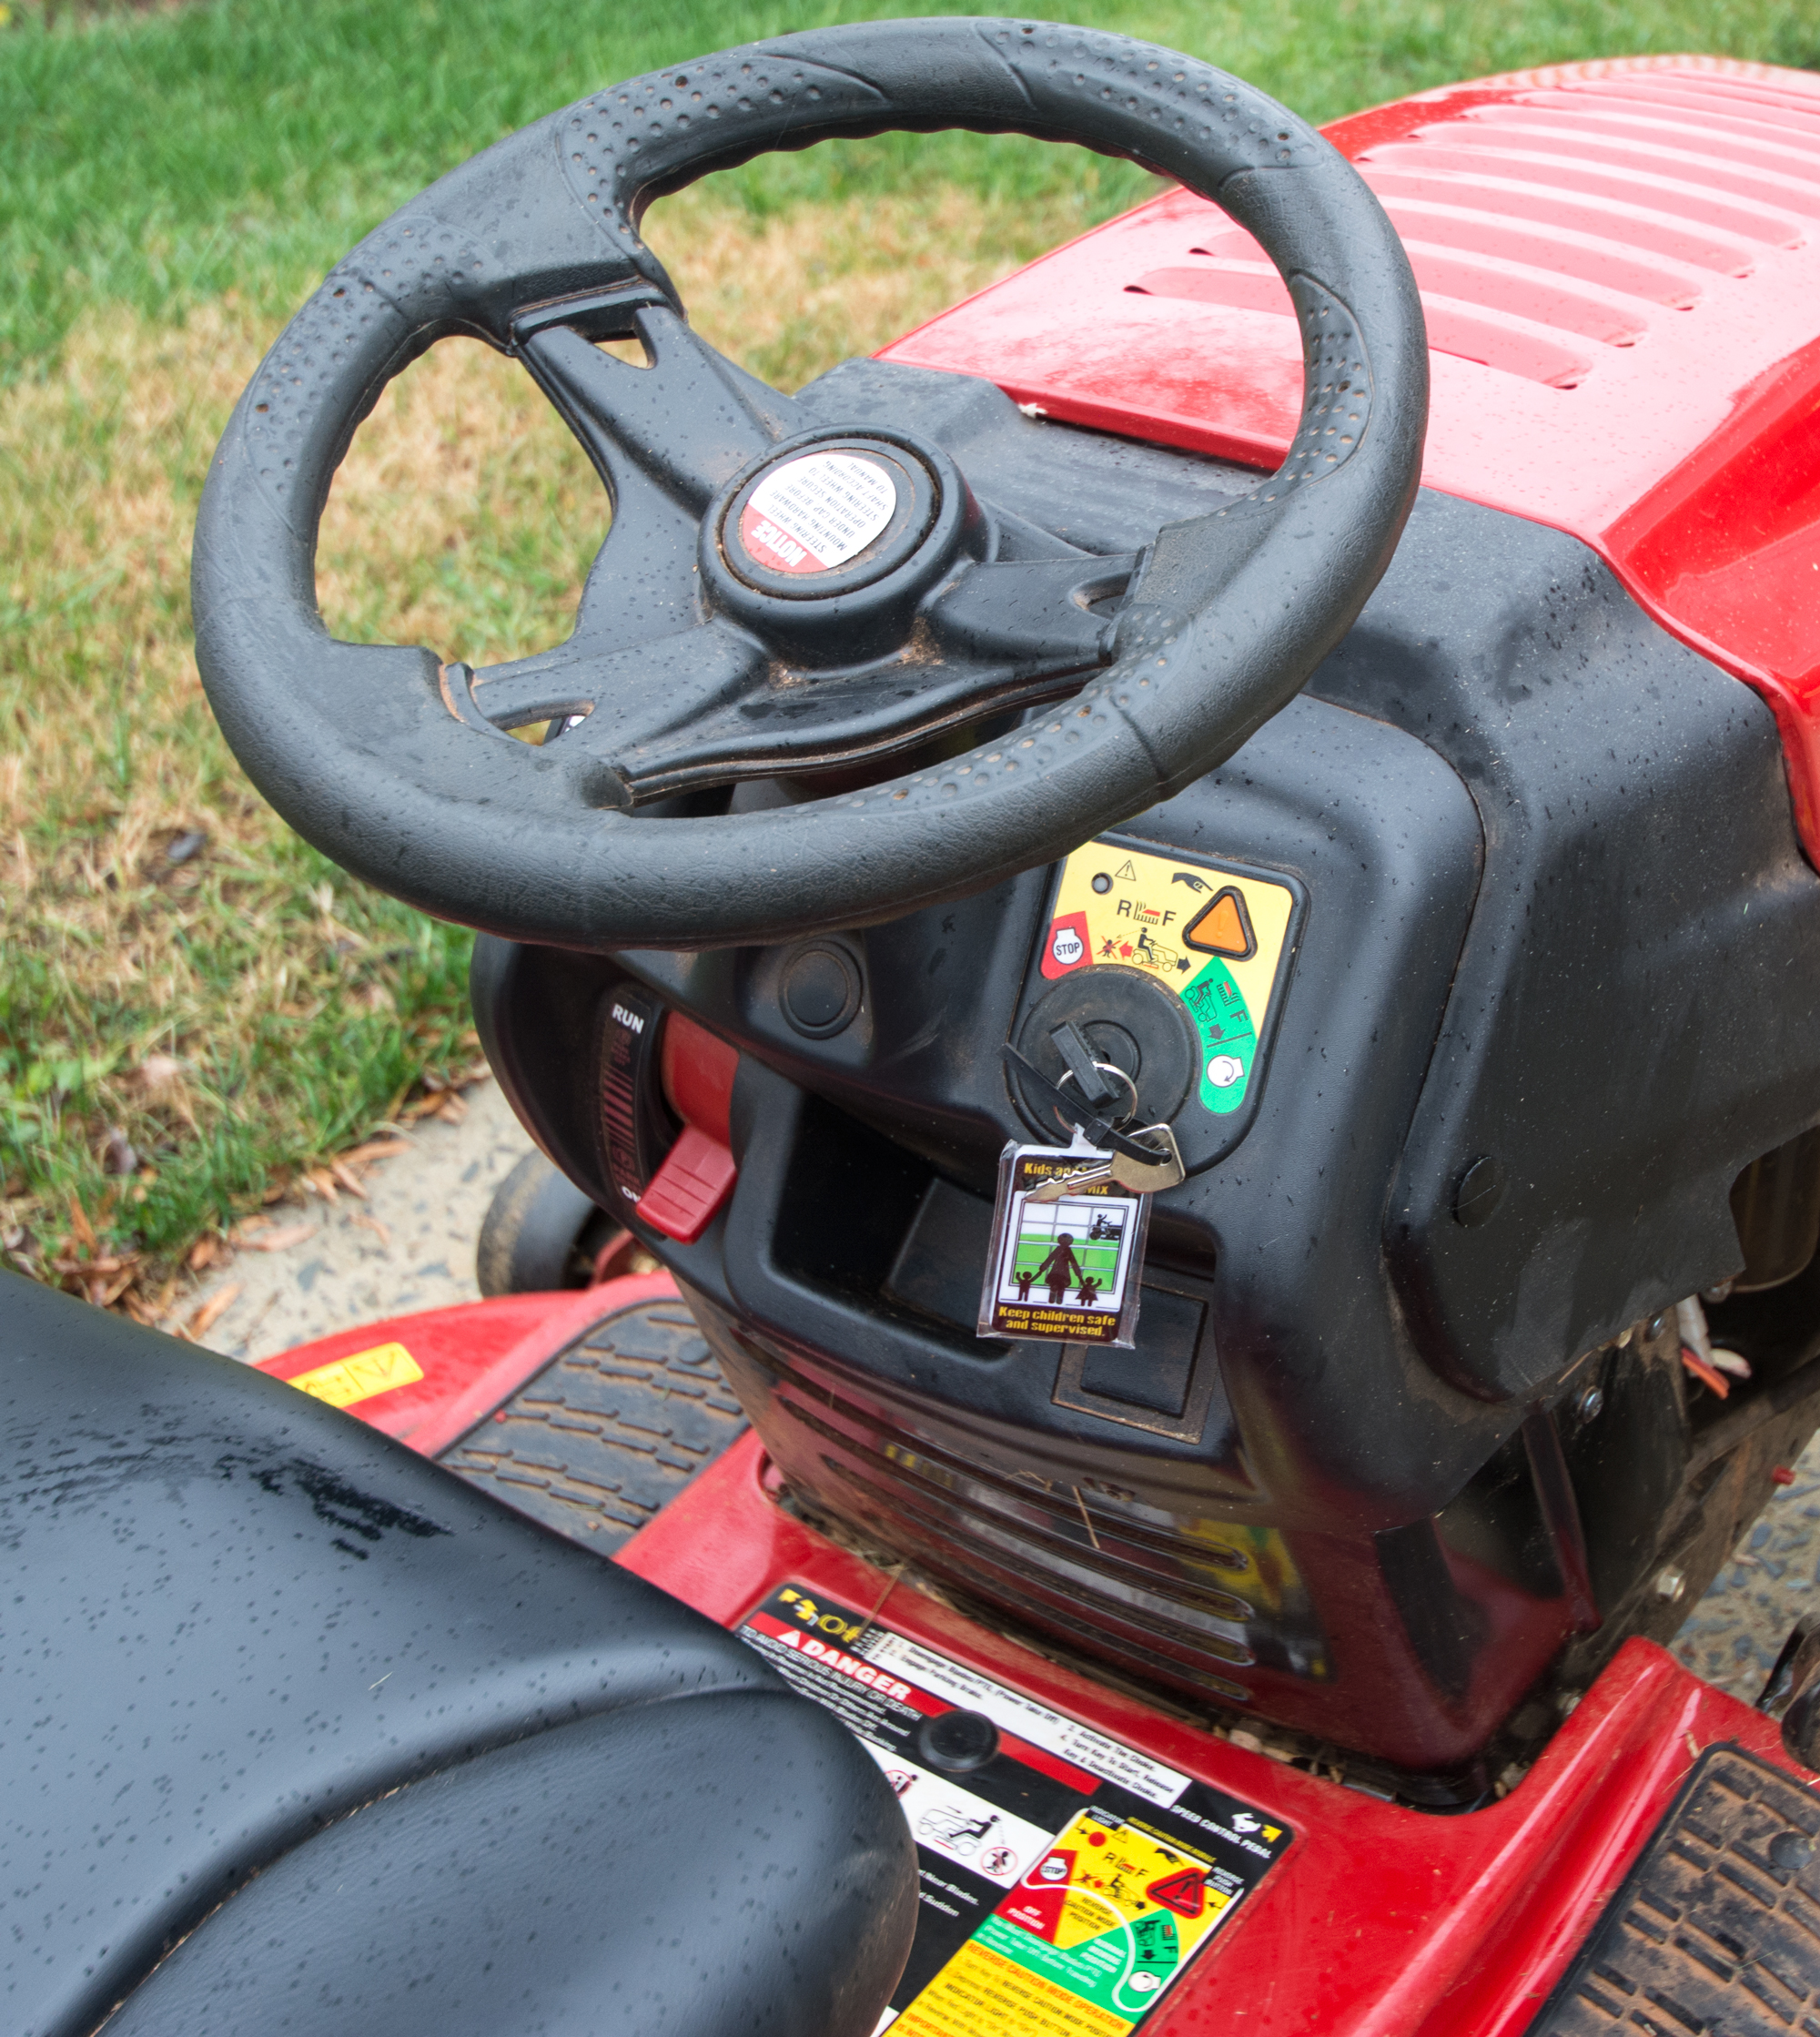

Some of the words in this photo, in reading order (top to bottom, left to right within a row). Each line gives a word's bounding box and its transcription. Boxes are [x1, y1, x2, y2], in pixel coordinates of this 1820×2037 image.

[807, 465, 820, 477] TO
[817, 471, 844, 494] WHEEL
[822, 458, 864, 494] ACCORDING
[846, 461, 877, 488] MANUAL
[784, 481, 814, 507] BEFORE
[796, 473, 826, 500] SECURE
[875, 482, 888, 495] TO
[769, 488, 810, 522] HARDWARE
[824, 493, 866, 530] OPERATION
[841, 489, 880, 522] STEERING
[860, 487, 888, 512] SHAFT
[765, 502, 792, 526] WHEEL
[827, 514, 855, 539] UNDER
[749, 517, 808, 569] NOTICE
[789, 521, 827, 553] STEERING
[806, 517, 848, 552] MOUNTING
[1117, 899, 1133, 917] R
[1162, 910, 1177, 927] F
[1056, 941, 1080, 956] STOP
[612, 1003, 644, 1034] RUN
[1024, 1162, 1053, 1176] Kids
[998, 1306, 1030, 1320] Keep
[1032, 1309, 1085, 1323] children
[1087, 1313, 1116, 1326] safe
[1006, 1320, 1028, 1330] and
[1031, 1322, 1106, 1337] supervised.
[800, 1636, 913, 1702] DANGER
[906, 1645, 947, 1670] Disengage
[738, 1624, 759, 1639] TO
[753, 1632, 789, 1655] AVOID
[784, 1647, 834, 1677] SERIOUS
[829, 1669, 871, 1696] INJURY
[865, 1688, 888, 1704] OR
[884, 1697, 924, 1722] DEATH
[897, 1653, 929, 1674] Engage
[926, 1667, 959, 1689] Parking
[774, 1654, 809, 1675] Reverse
[827, 1681, 888, 1716] Recommended.
[797, 1676, 833, 1698] Children
[829, 1692, 844, 1703] Or
[839, 1698, 868, 1716] Others
[878, 1717, 911, 1738] Around
[834, 1706, 864, 1724] Blades
[1077, 1728, 1114, 1751] Activate
[1061, 1747, 1079, 1760] Key
[1078, 1755, 1088, 1764] &
[1087, 1758, 1131, 1786] Deactivate
[1069, 1738, 1090, 1753] Turn
[1088, 1748, 1107, 1761] Key
[1106, 1756, 1118, 1766] To
[1142, 1773, 1177, 1795] Release
[1087, 1802, 1126, 1826] INDICATOR
[1089, 1811, 1115, 1829] LIGHT
[1168, 1802, 1203, 1825] SPEED
[1198, 1817, 1243, 1846] CONTROL
[1239, 1837, 1274, 1860] PEDAL
[1102, 1850, 1118, 1864] R
[1135, 1867, 1149, 1880] F
[1210, 1873, 1235, 1889] PUSH
[945, 1883, 980, 1906] Blades.
[1202, 1876, 1235, 1897] BUTTON
[925, 1895, 960, 1918] Sudden
[1006, 1906, 1046, 1931] POSITION
[1021, 1903, 1043, 1919] OFF
[1064, 1899, 1095, 1918] CAUTION
[1094, 1913, 1117, 1929] MODE
[1067, 1910, 1102, 1931] POSITION
[1077, 1950, 1118, 1975] POSITION
[964, 1941, 1009, 1970] REVERSE
[1005, 1963, 1049, 1991] CAUTION
[1045, 1984, 1076, 2005] MODE
[1071, 1998, 1127, 2032] OPERATION
[942, 1981, 986, 2008] INDICATOR
[983, 2003, 1010, 2021] LIGHT
[981, 1986, 1018, 2010] REVERSE
[1016, 2005, 1040, 2022] PUSH
[999, 1979, 1034, 2000] REVERSE
[1031, 1995, 1064, 2016] CAUTION
[1062, 2012, 1085, 2027] MODE
